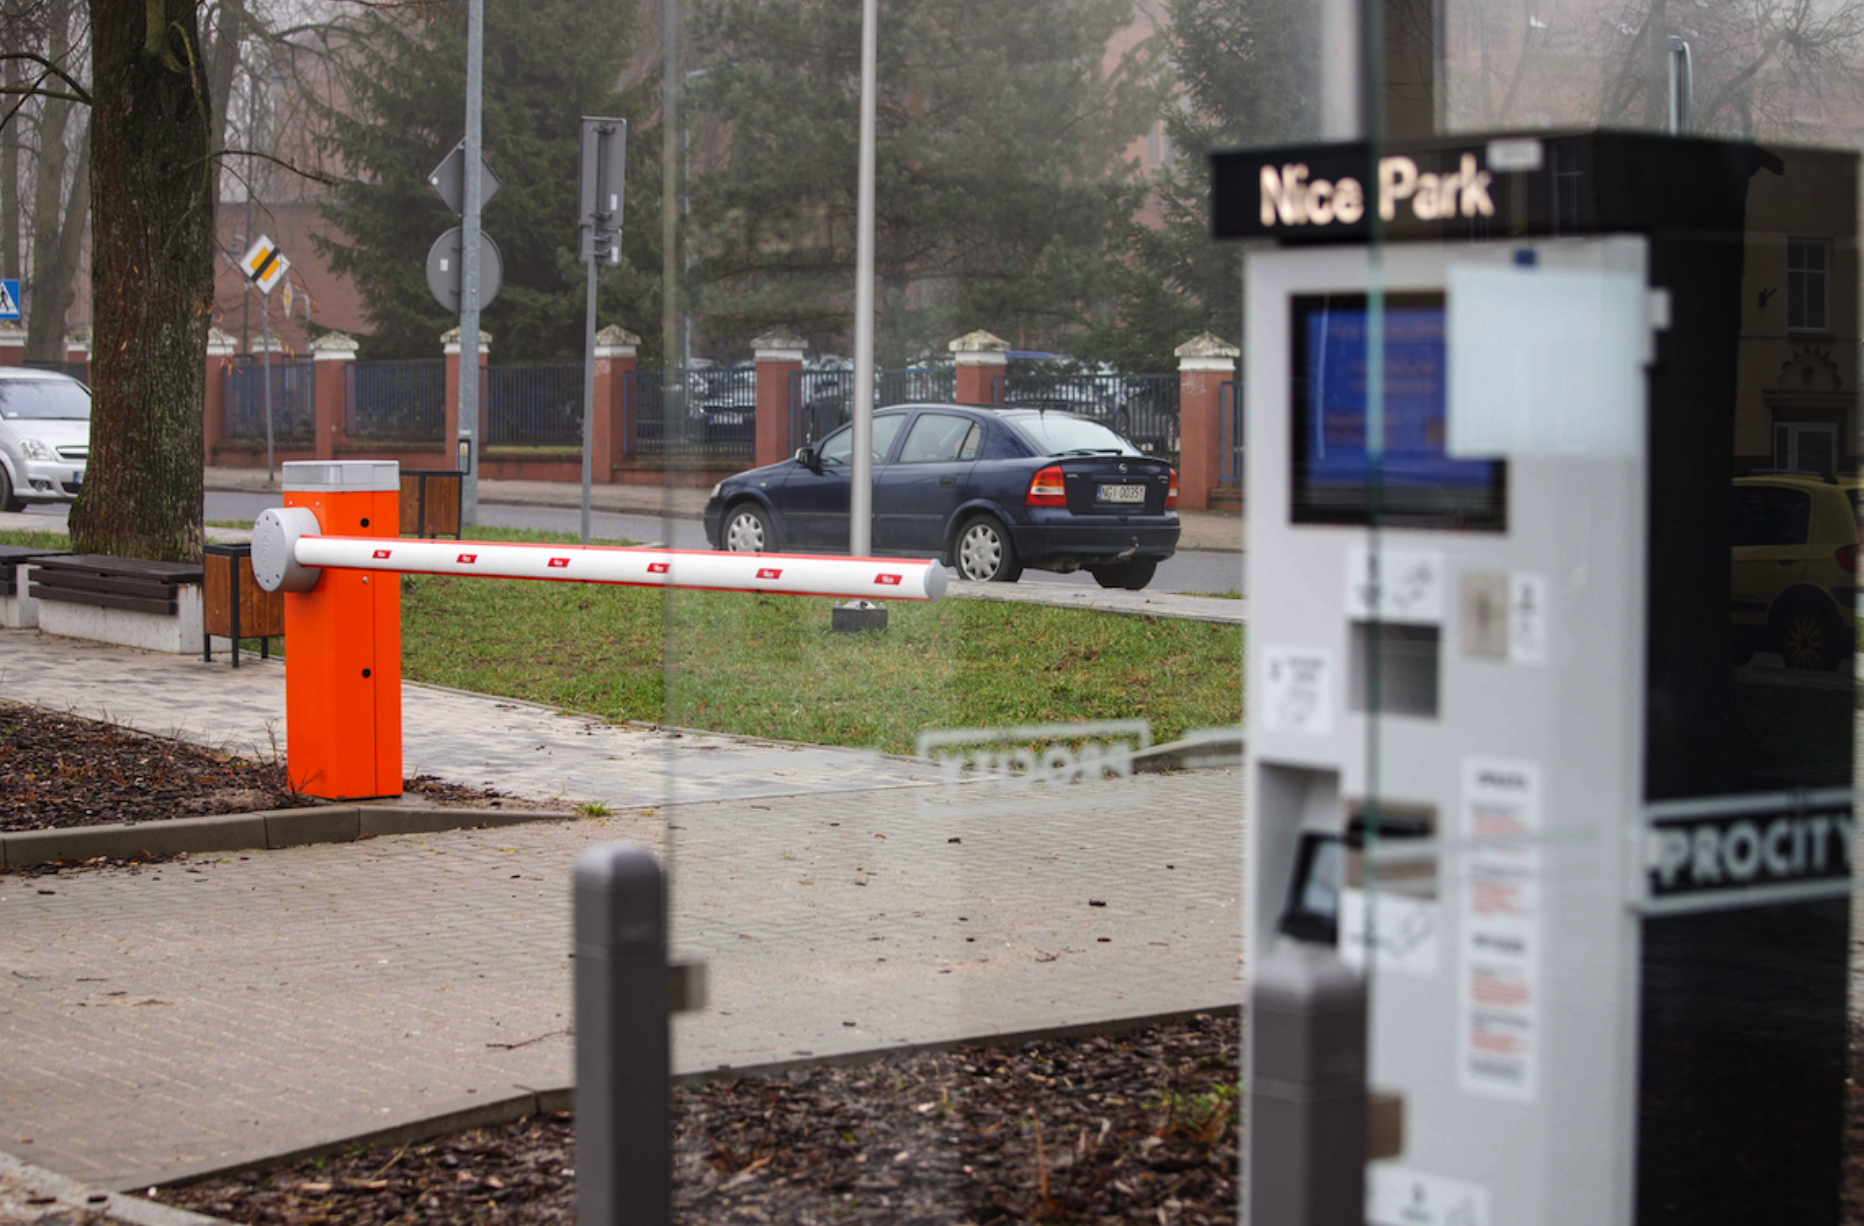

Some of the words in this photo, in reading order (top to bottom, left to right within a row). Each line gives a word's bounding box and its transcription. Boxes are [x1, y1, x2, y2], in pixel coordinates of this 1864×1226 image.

[1260, 163, 1364, 227] Nice
[1378, 153, 1495, 222] Park
[1101, 485, 1116, 498] NGI
[1119, 486, 1144, 499] 00351
